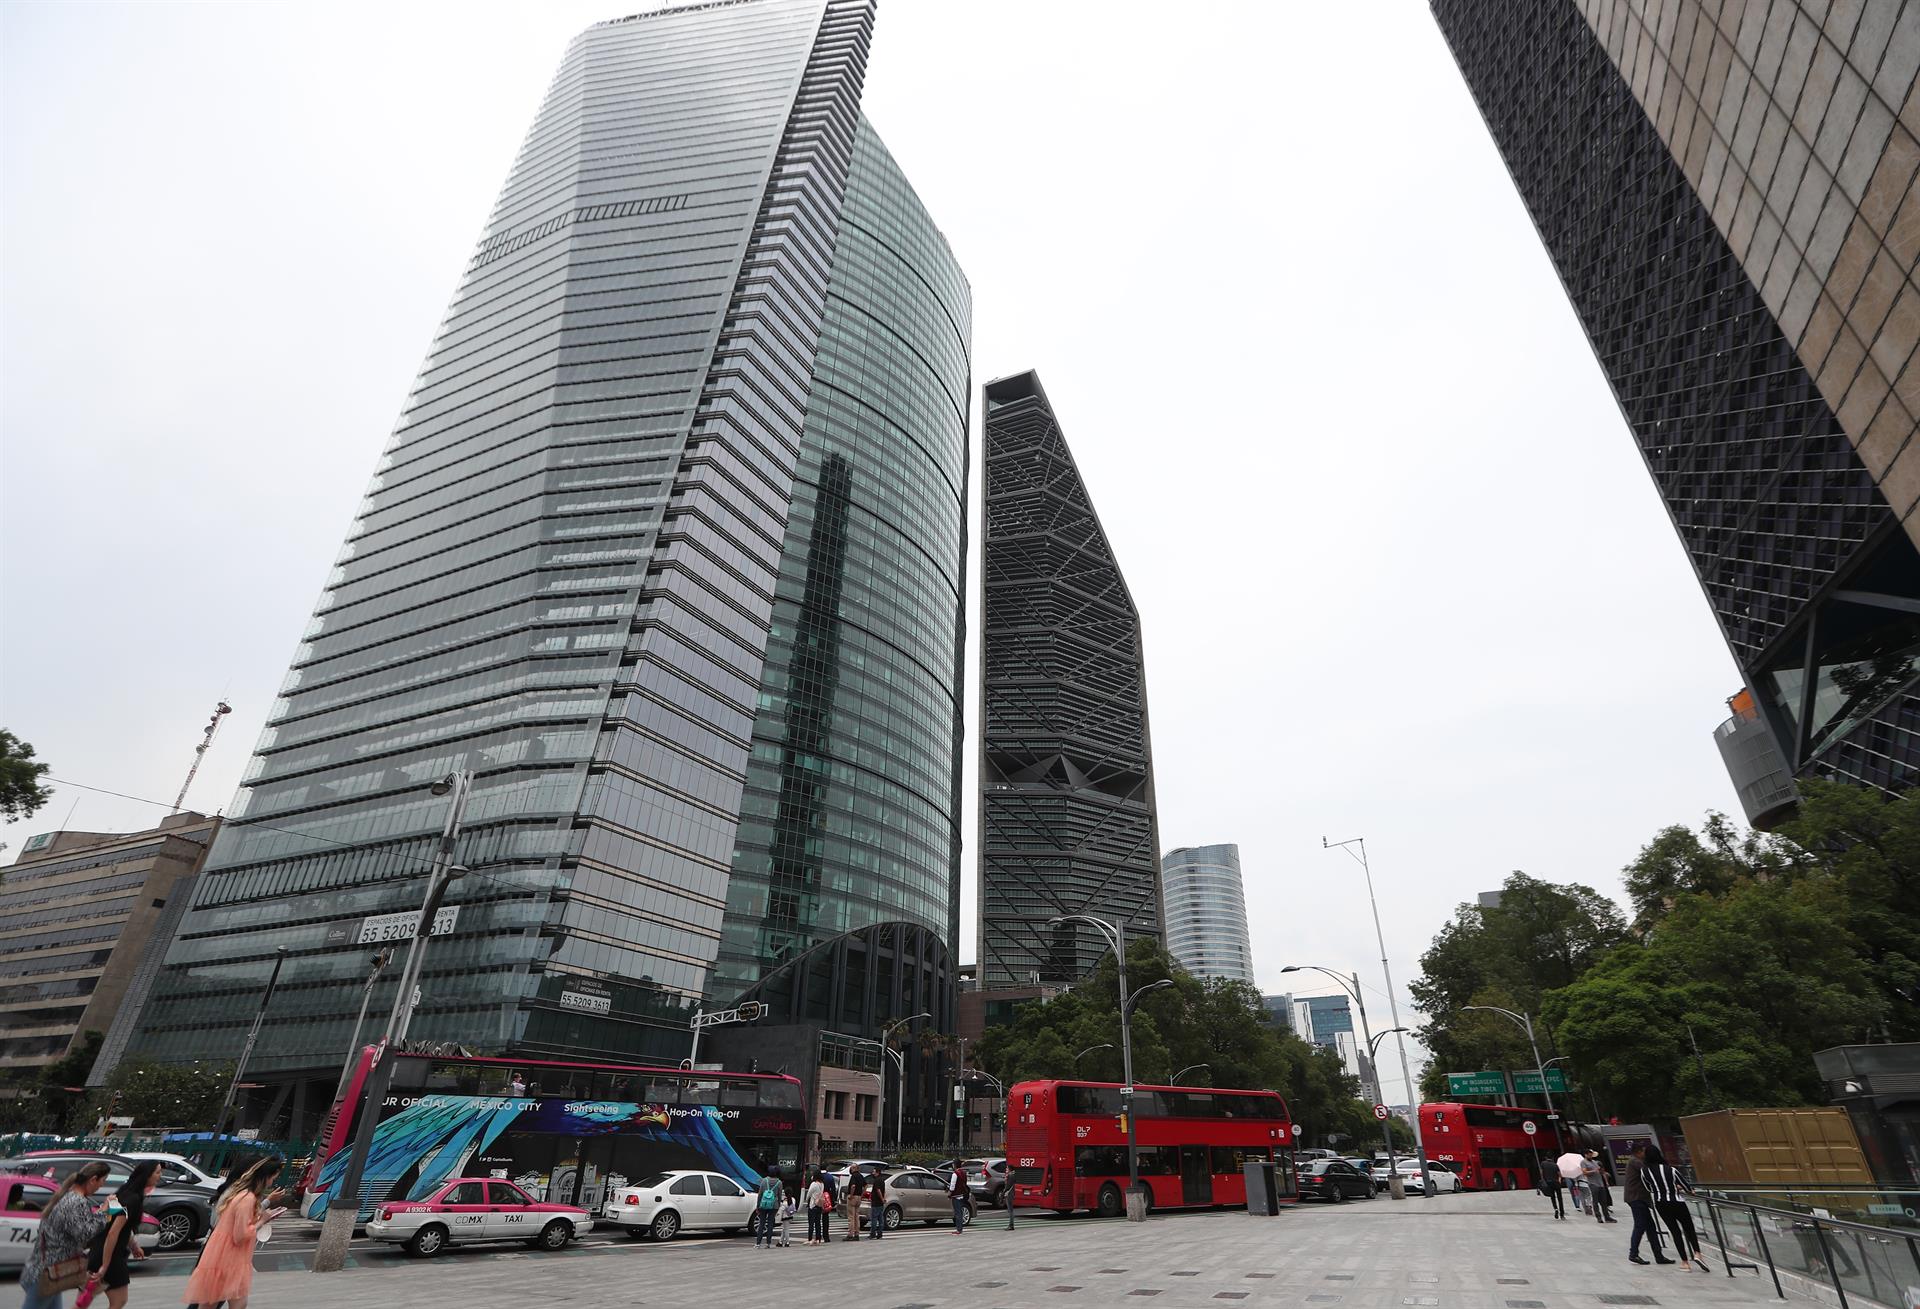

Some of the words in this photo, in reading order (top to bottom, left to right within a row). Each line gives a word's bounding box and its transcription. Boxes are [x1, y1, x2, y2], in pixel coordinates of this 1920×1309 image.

[367, 916, 392, 926] ESPACIOS
[393, 915, 401, 923] DE
[362, 927, 378, 942] 55
[382, 922, 416, 940] 5209
[430, 918, 453, 935] 613
[562, 994, 572, 1006] 55
[573, 996, 592, 1009] 5209
[593, 999, 610, 1012] 3613
[401, 1097, 447, 1108] OFICIAL
[470, 1100, 513, 1111] MEXICO
[517, 1102, 542, 1112] CITY
[564, 1103, 619, 1115] Sightseeing
[669, 1107, 703, 1118] Hop-On
[706, 1110, 740, 1119] Hop-Off
[778, 1159, 796, 1167] CDMX
[1020, 1157, 1036, 1167] 837
[455, 1215, 483, 1225] CDMX
[504, 1214, 524, 1223] TAXI
